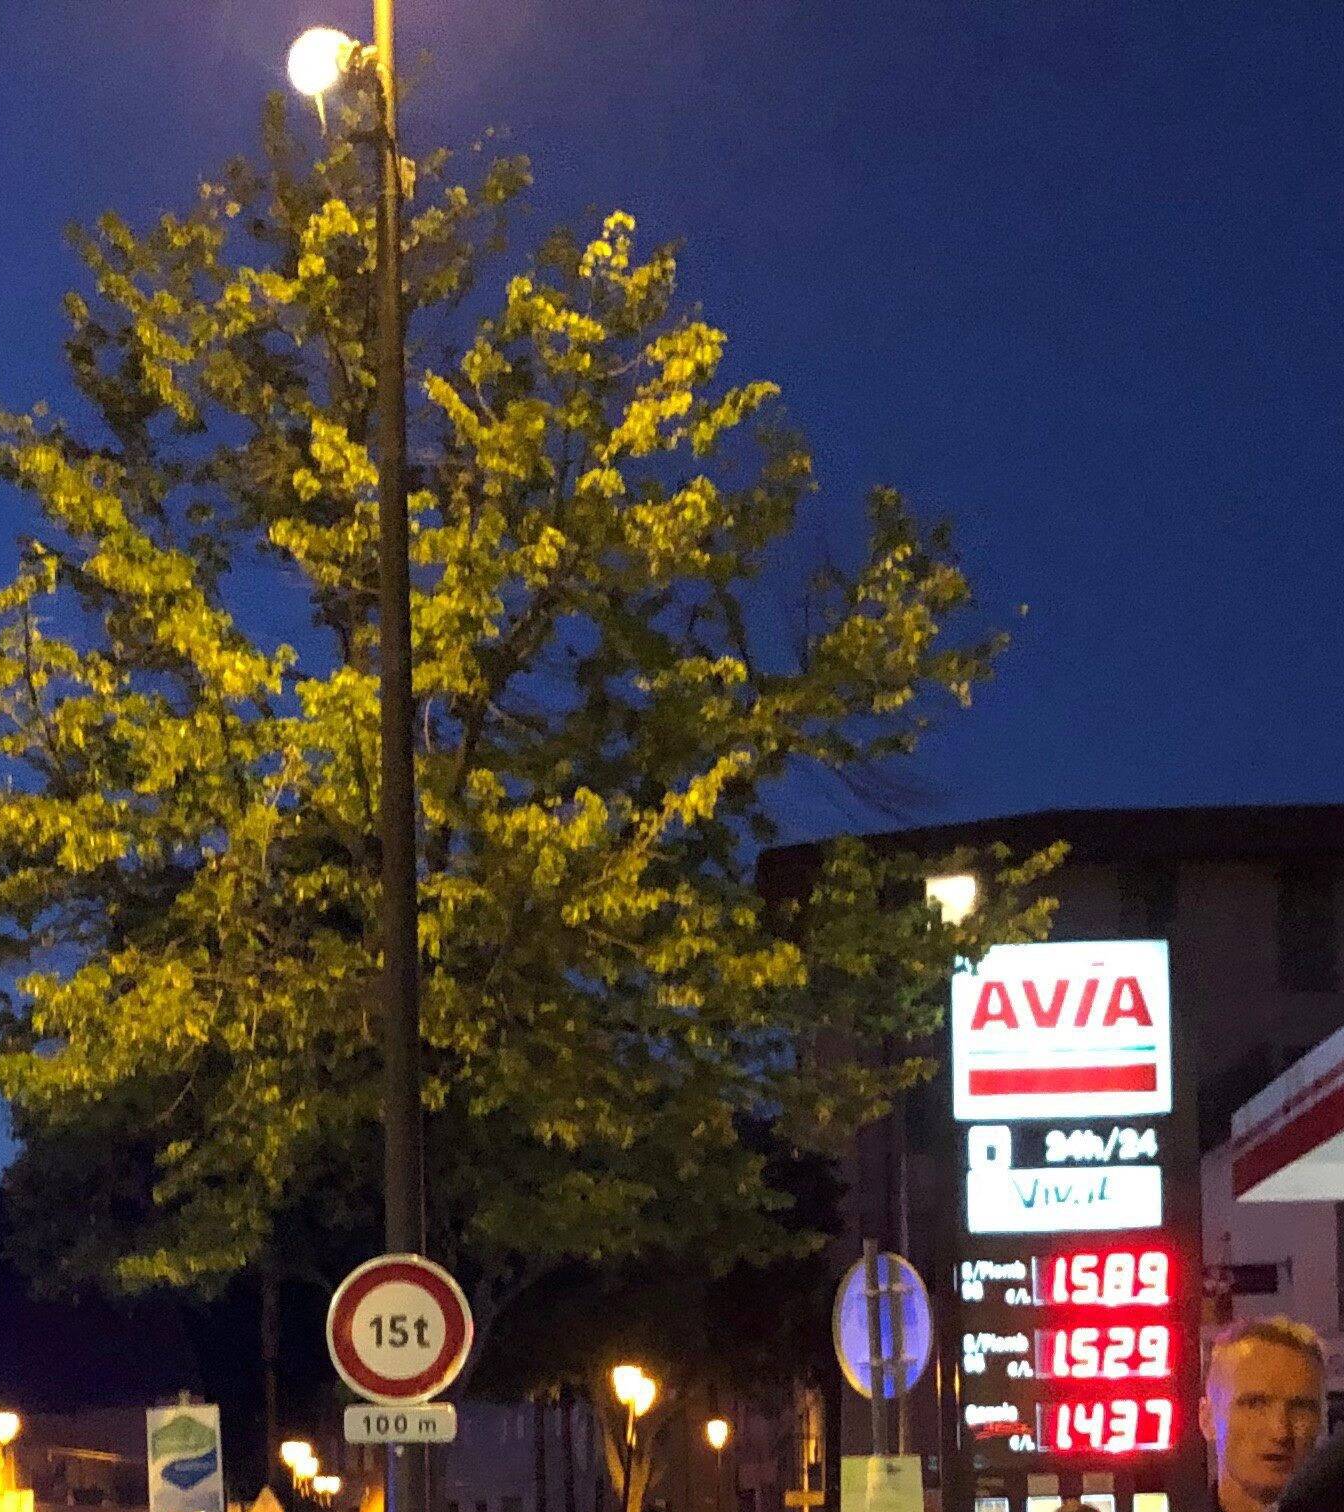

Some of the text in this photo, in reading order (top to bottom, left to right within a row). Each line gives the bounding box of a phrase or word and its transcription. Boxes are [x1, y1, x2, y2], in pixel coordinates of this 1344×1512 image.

[970, 961, 1154, 1030] AVIA
[362, 1414, 437, 1437] 100 m
